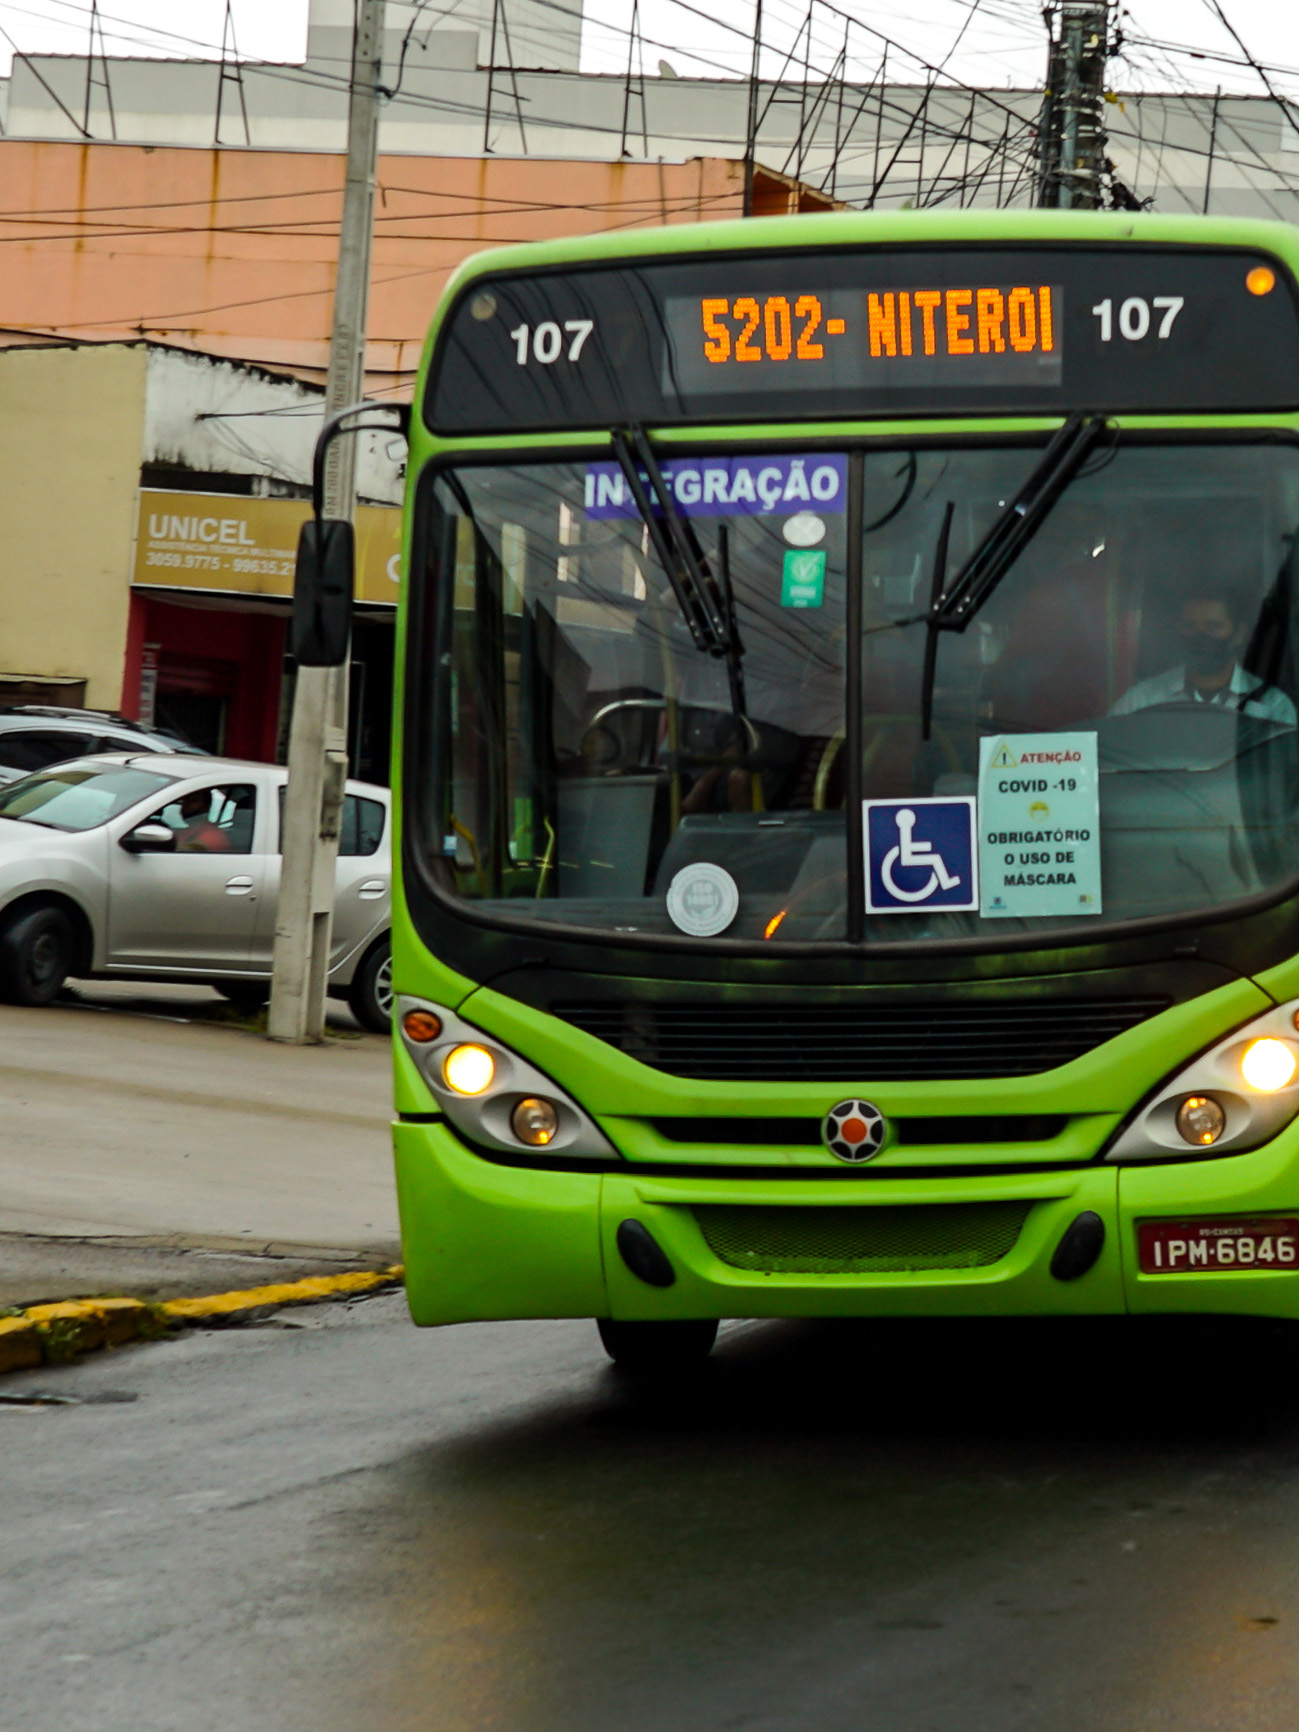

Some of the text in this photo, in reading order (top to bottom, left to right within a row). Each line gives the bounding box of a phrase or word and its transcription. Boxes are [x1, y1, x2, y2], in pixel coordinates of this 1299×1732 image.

[702, 286, 1053, 363] 5202- NITEROI
[1092, 296, 1185, 342] 107
[510, 320, 594, 365] 107
[150, 513, 256, 545] UNICEL
[1020, 749, 1081, 765] ATENÇÃO
[998, 779, 1048, 793] COVID
[987, 826, 1091, 845] OBRIGATÓRIO
[1004, 851, 1075, 865] O USO DE
[1004, 872, 1077, 887] MÁSCARA
